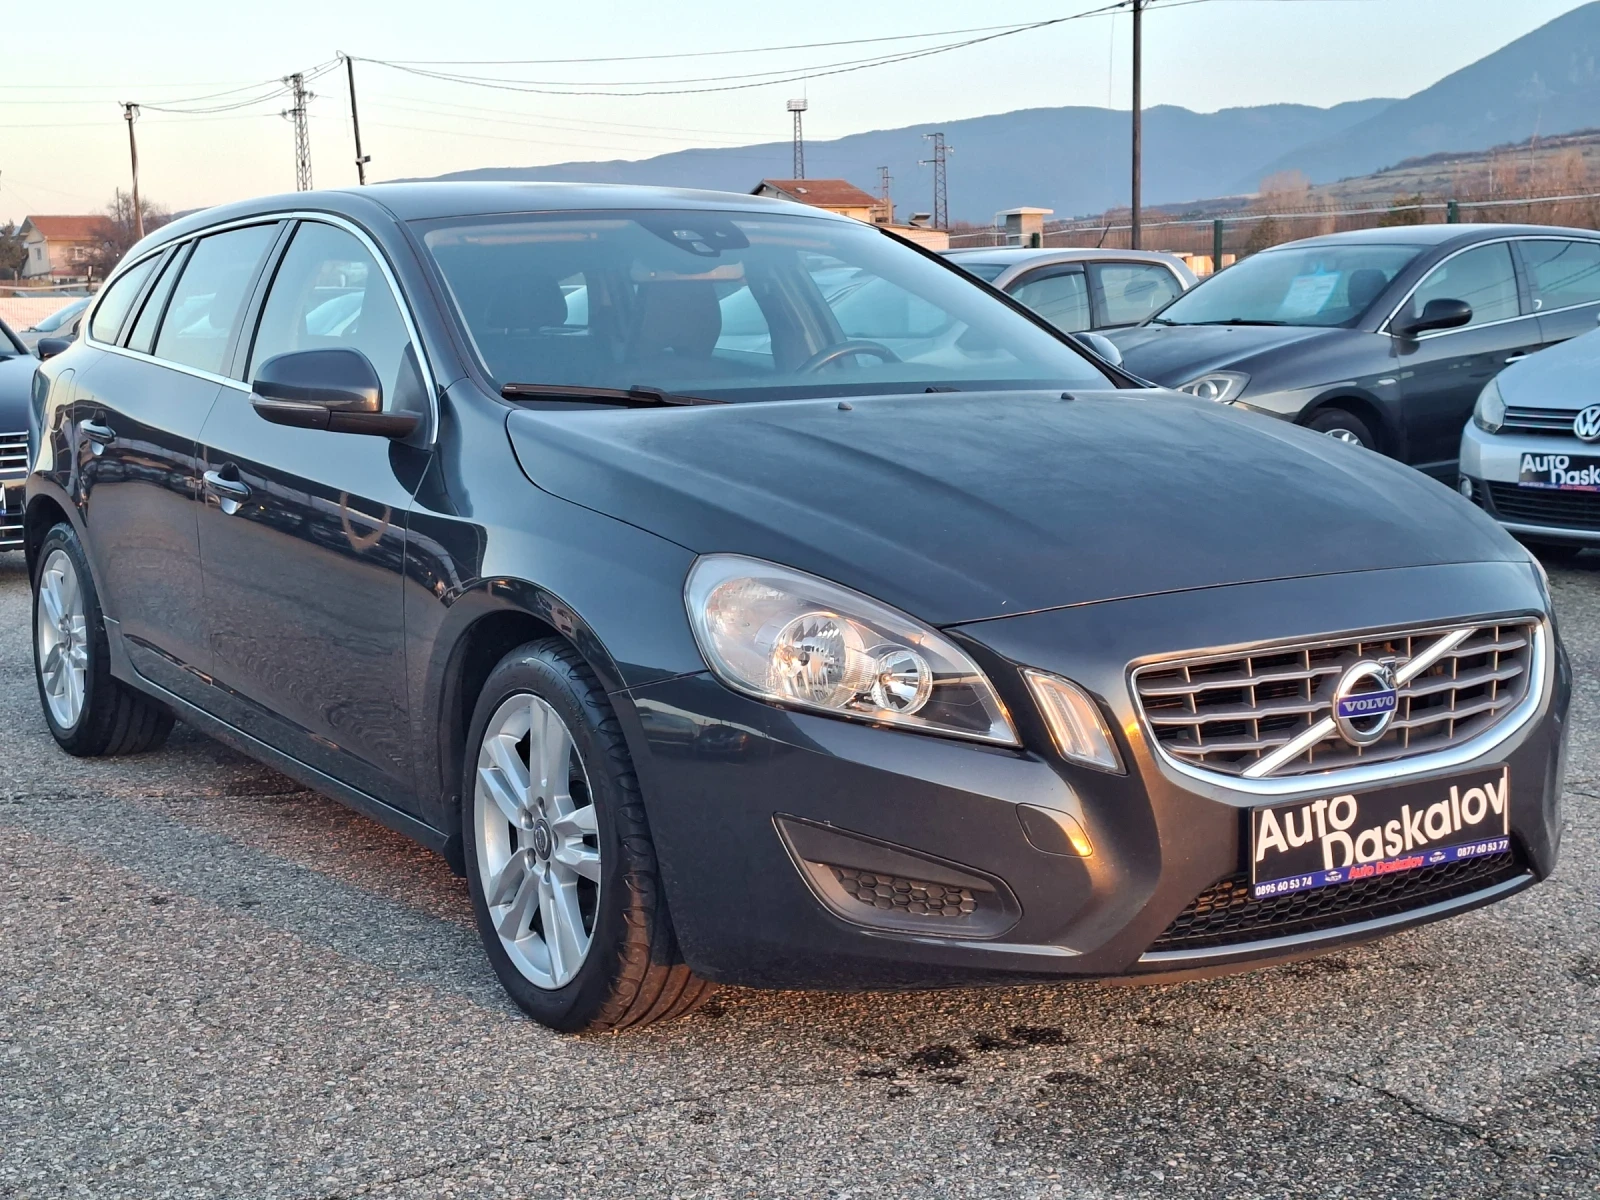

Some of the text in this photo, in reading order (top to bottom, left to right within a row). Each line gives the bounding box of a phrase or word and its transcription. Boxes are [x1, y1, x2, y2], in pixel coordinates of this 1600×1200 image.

[1521, 454, 1569, 473] Auto
[1343, 696, 1394, 712] VOLVO
[1256, 795, 1357, 862] Auto
[1322, 777, 1507, 870] Daskalov
[1255, 884, 1276, 896] 0895
[1277, 881, 1288, 892] 60
[1289, 879, 1300, 889] 53
[1302, 876, 1312, 887] 74
[1348, 864, 1374, 880] Auto
[1457, 845, 1476, 857] 0877
[1476, 843, 1486, 854] 60
[1487, 842, 1497, 851] 53
[1498, 840, 1508, 849] 77
